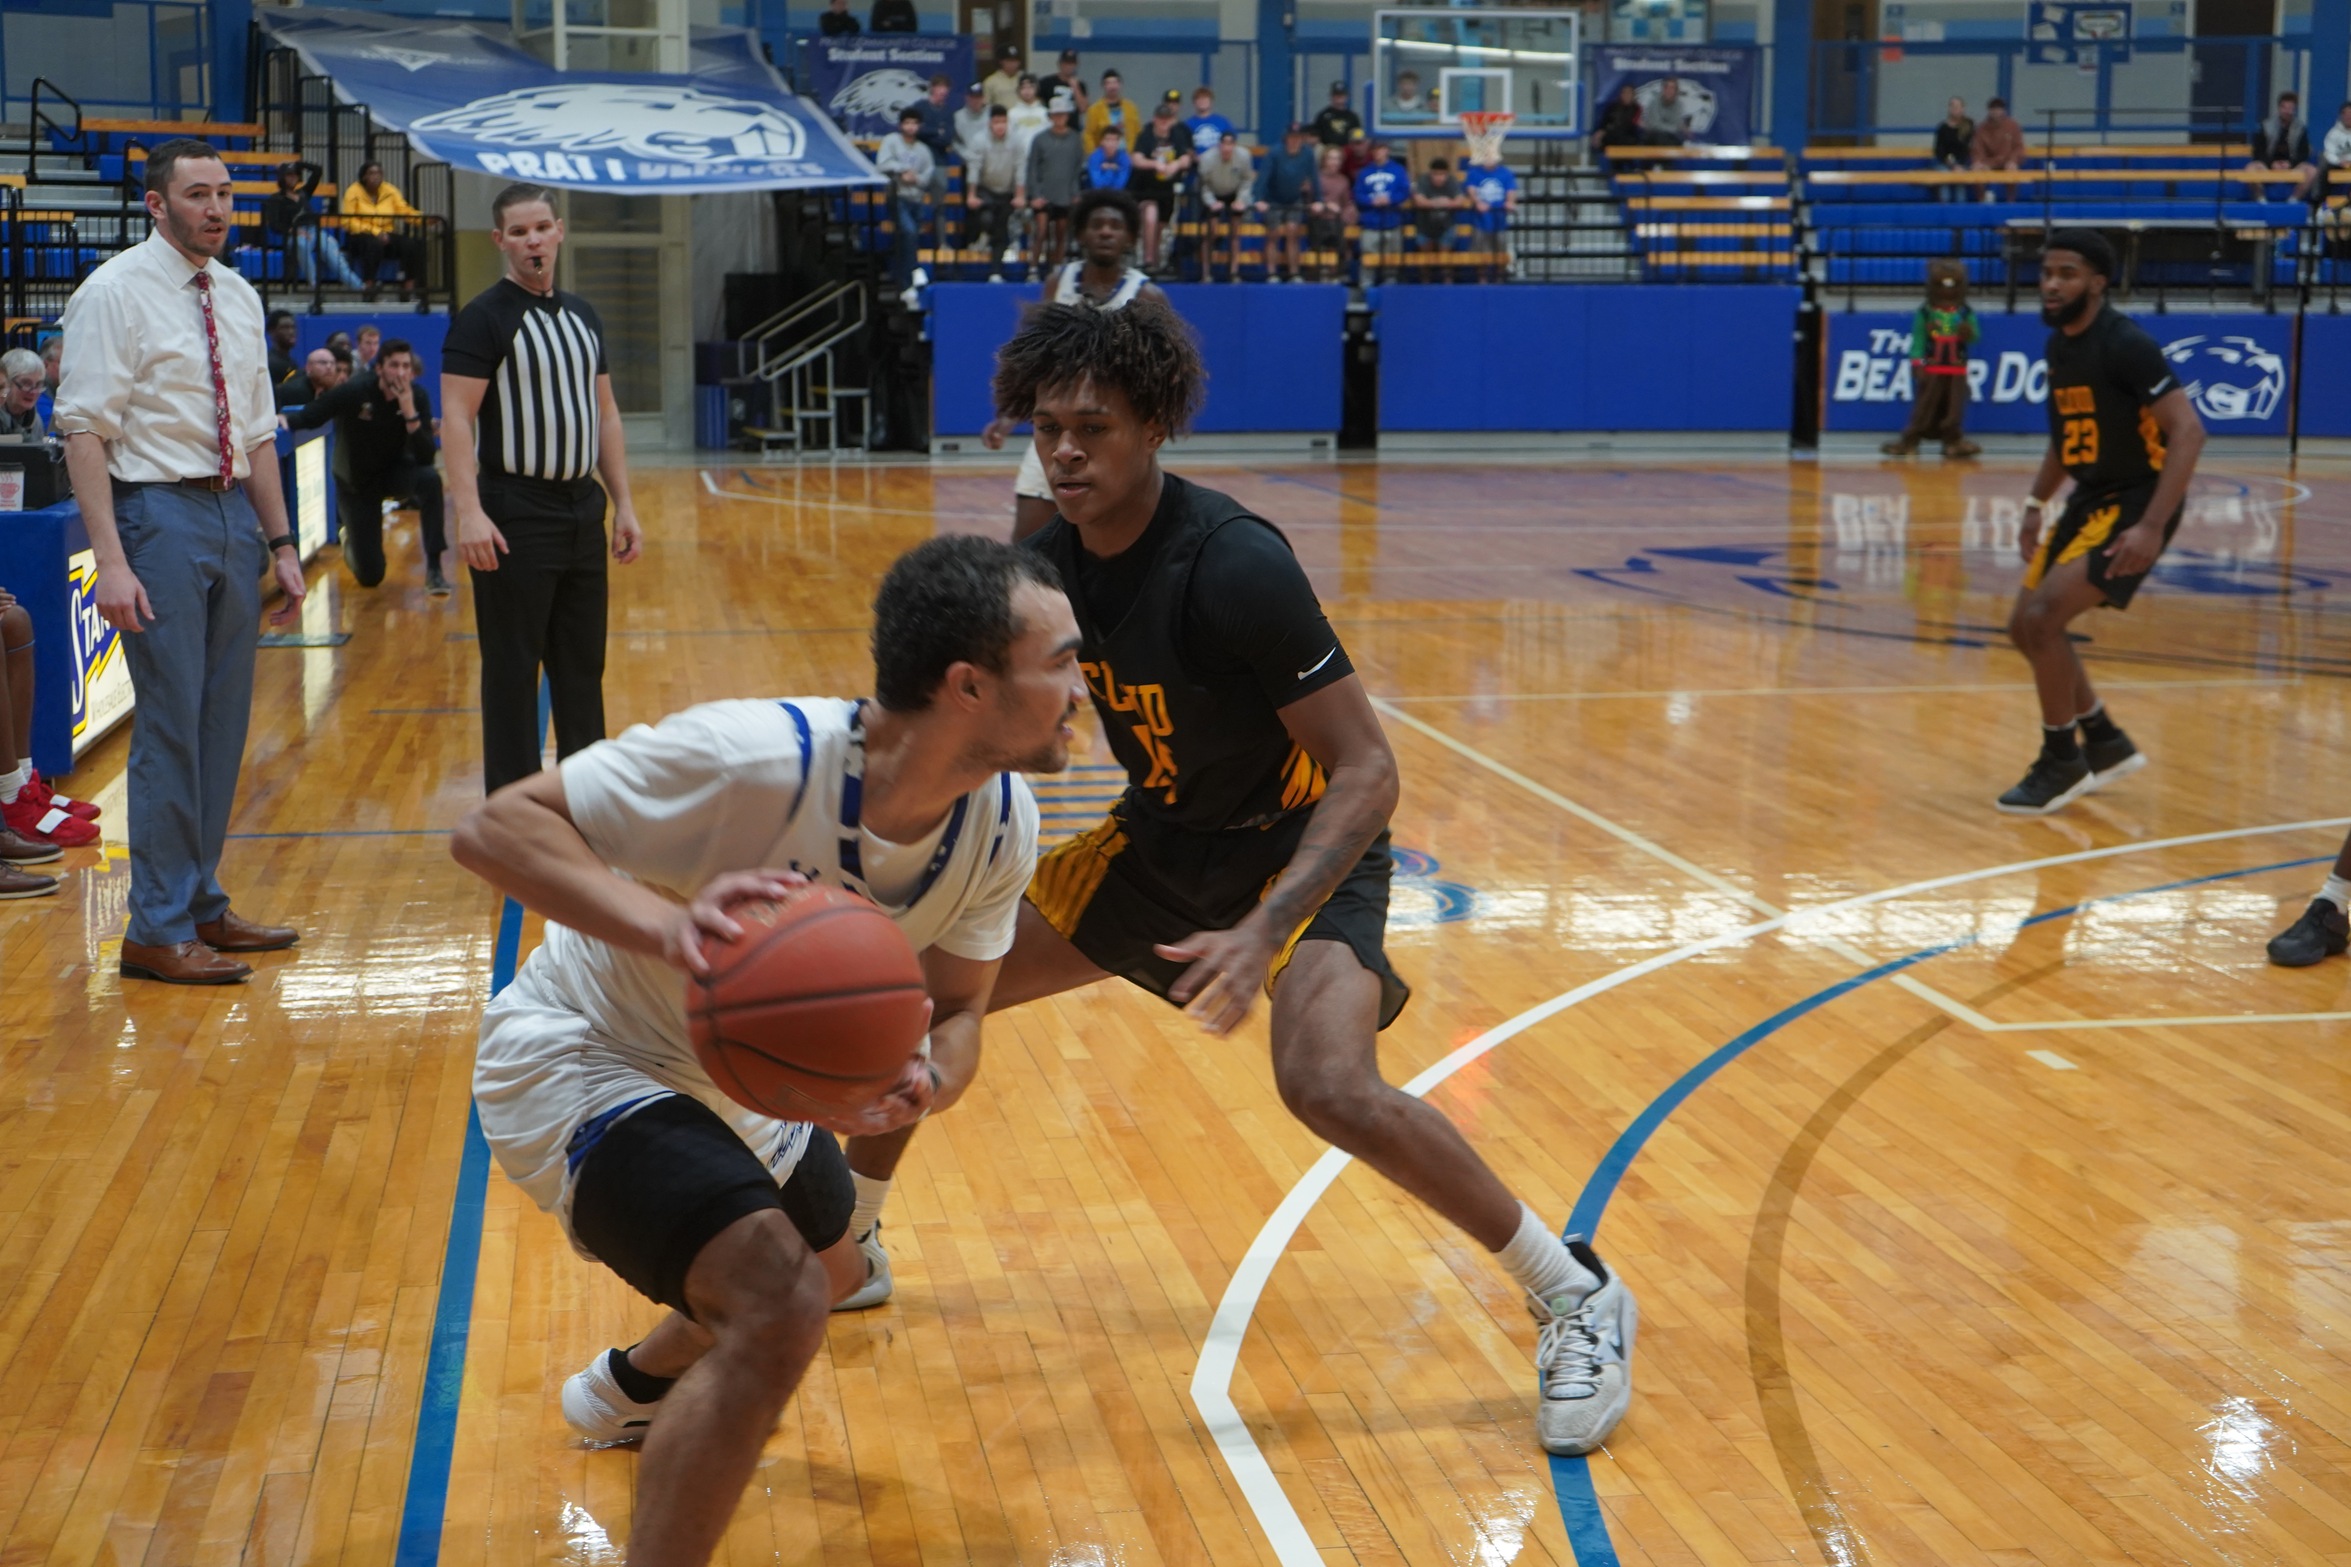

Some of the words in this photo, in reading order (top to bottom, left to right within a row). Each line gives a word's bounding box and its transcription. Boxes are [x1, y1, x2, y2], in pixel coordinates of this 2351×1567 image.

[828, 47, 886, 62] Student
[888, 47, 945, 63] Section
[1868, 328, 1914, 354] TH
[1833, 350, 1989, 402] BEAR
[2061, 418, 2099, 466] 23
